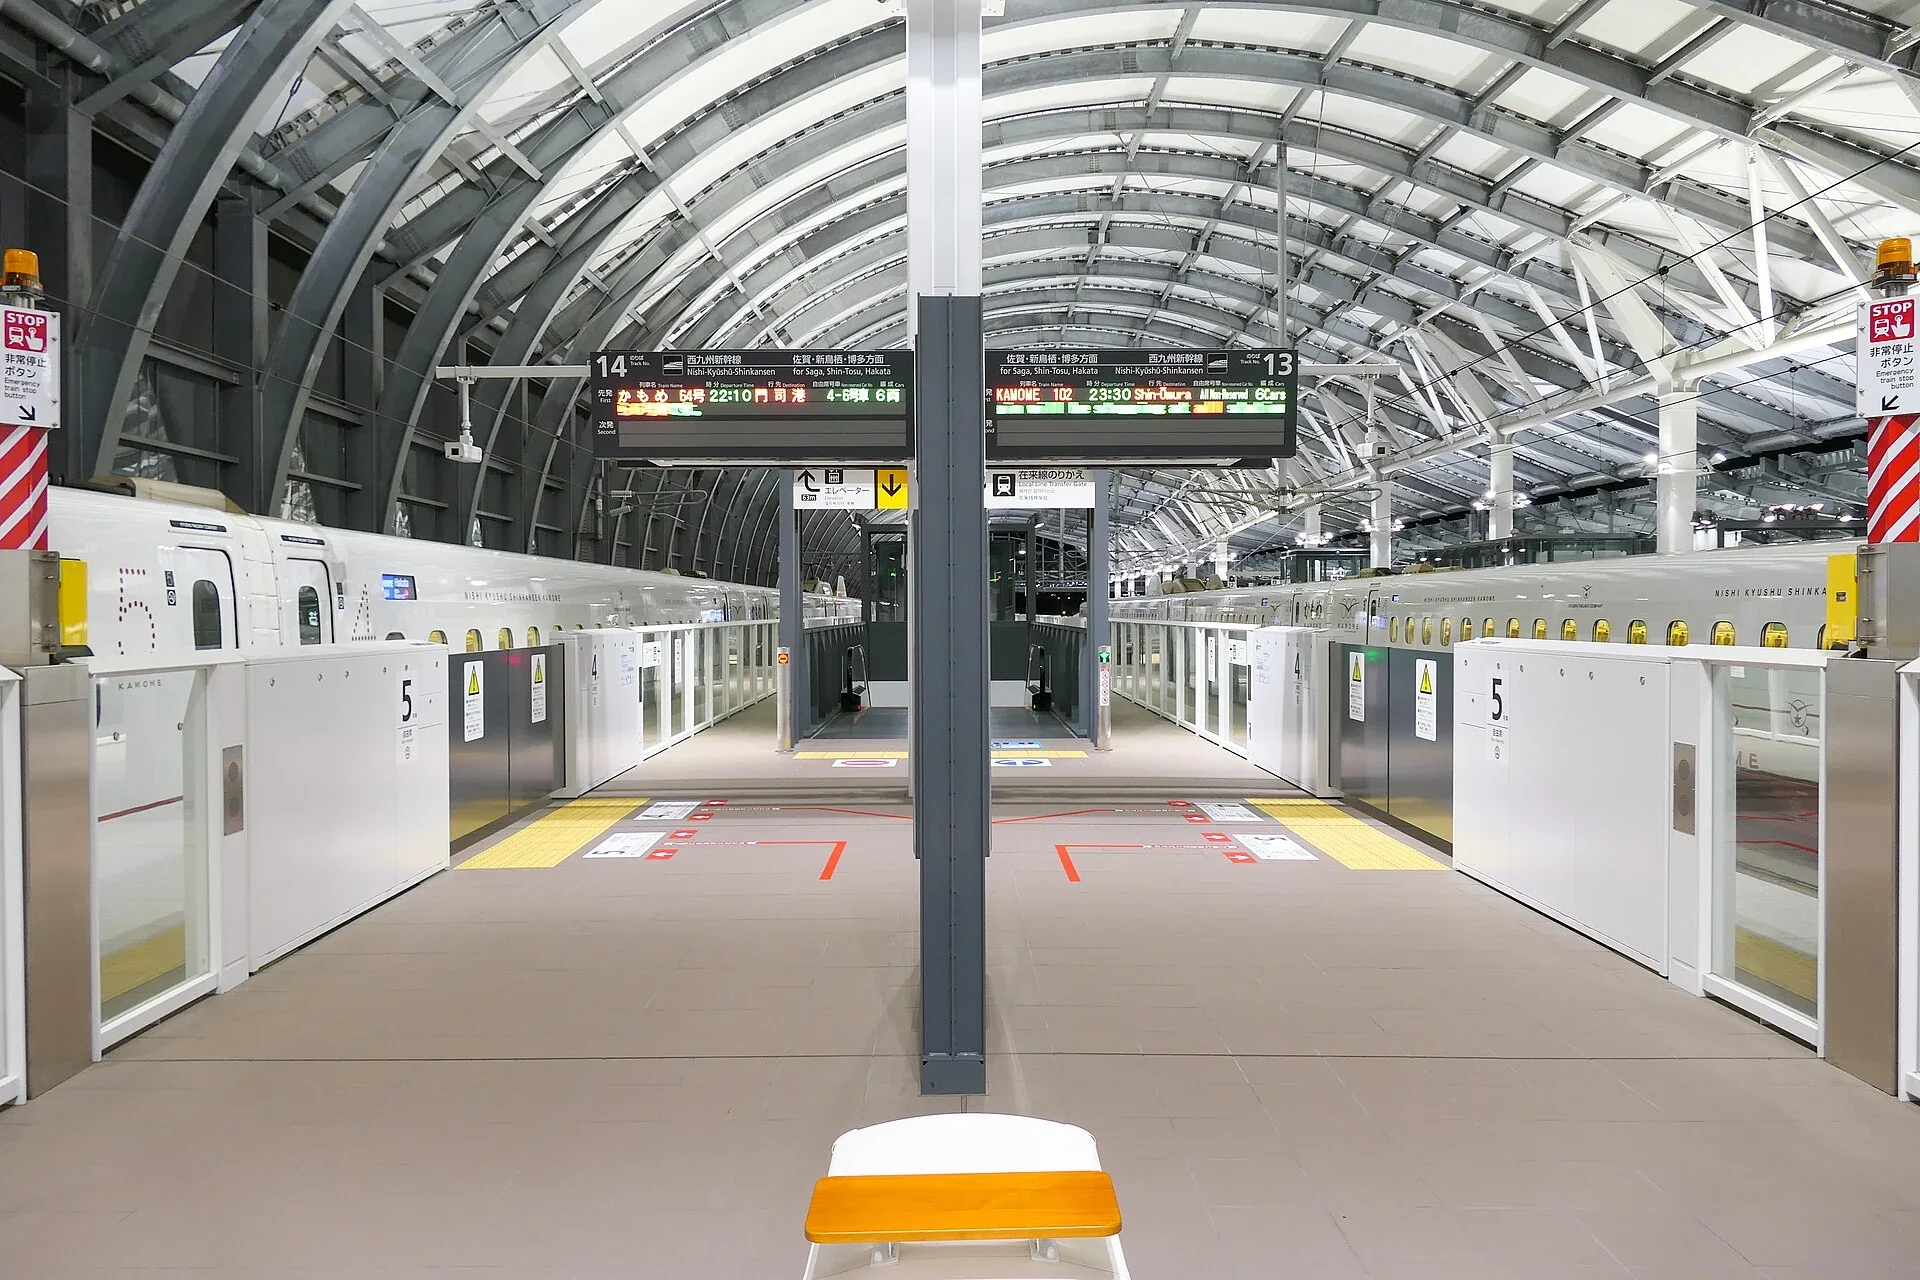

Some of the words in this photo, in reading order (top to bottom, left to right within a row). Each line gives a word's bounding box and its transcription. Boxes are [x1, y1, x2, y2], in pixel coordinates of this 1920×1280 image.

[1873, 302, 1912, 317] STOP
[7, 313, 45, 326] STOP
[1870, 344, 1914, 357] 非常停止
[5, 354, 47, 368] 非常停止
[687, 355, 742, 365] 西九州新幹線
[793, 354, 884, 364] 佐賀・新鳥栖・博多方面
[1006, 354, 1098, 364] 佐賀・新鳥栖・博多方面
[1149, 353, 1203, 364] 西九州新幹線
[1881, 357, 1914, 369] ボタン
[596, 355, 628, 378] 14
[1263, 353, 1293, 376] 13
[5, 367, 36, 378] ボタン
[687, 368, 776, 377] Nishi-Kyūshū-Shinkansen
[793, 368, 805, 376] for
[805, 368, 825, 377] Saga,
[826, 368, 863, 377] Shin-Tosu,
[865, 368, 891, 376] Hakata
[1000, 367, 1011, 375] for
[1013, 367, 1032, 376] Saga,
[1034, 367, 1071, 376] Shin-Tosu,
[1072, 367, 1098, 375] Hakata
[1115, 366, 1204, 376] Nishi-Kyūshū-Shinkansen
[1876, 368, 1914, 378] Emergency
[4, 377, 41, 388] Emergency
[1880, 376, 1897, 384] train
[1898, 375, 1914, 383] stop
[4, 385, 20, 393] train
[22, 387, 37, 395] stop
[1891, 382, 1914, 390] button
[4, 392, 26, 400] button
[597, 389, 613, 397] 先発
[709, 389, 752, 403] 22:10
[995, 388, 1041, 401] KAMOME
[1053, 388, 1073, 401] 102
[1089, 388, 1132, 401] 23:30
[598, 421, 614, 429] 次発
[1018, 470, 1085, 480] 在来線のりかえ
[464, 591, 482, 600] NISHI
[485, 592, 507, 601] KYUSHU
[1715, 588, 1740, 597] NISHI
[1744, 588, 1783, 597] KYUSHU
[591, 654, 598, 681] 4
[1294, 652, 1300, 680] 4
[118, 679, 162, 690] KAMOME
[402, 679, 412, 722] 5
[1492, 677, 1503, 721] 5
